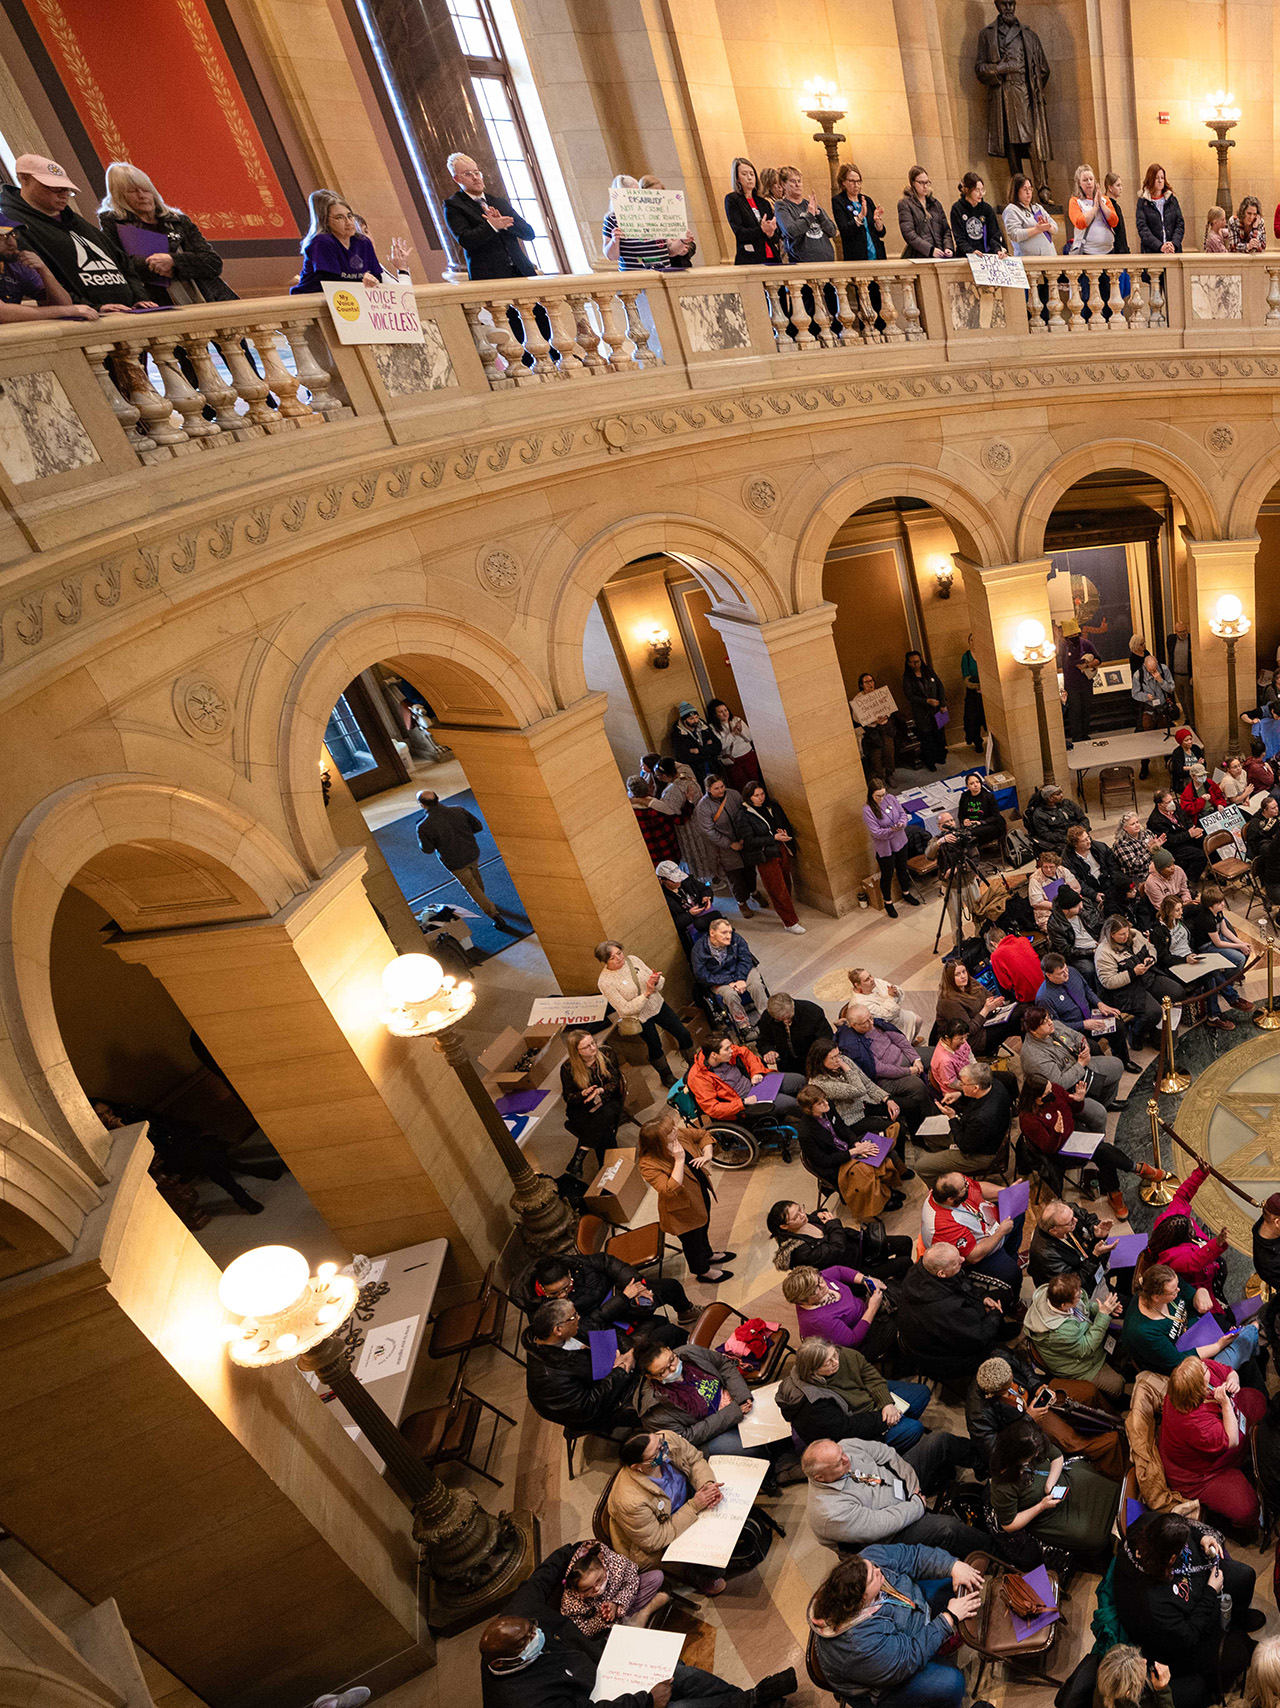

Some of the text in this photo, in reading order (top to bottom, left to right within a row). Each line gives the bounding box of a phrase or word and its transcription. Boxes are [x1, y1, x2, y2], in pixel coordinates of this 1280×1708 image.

[365, 291, 397, 304] VOICE
[368, 312, 419, 332] VOICELESS
[1221, 805, 1238, 820] HELP
[1169, 1326, 1177, 1340] MY
